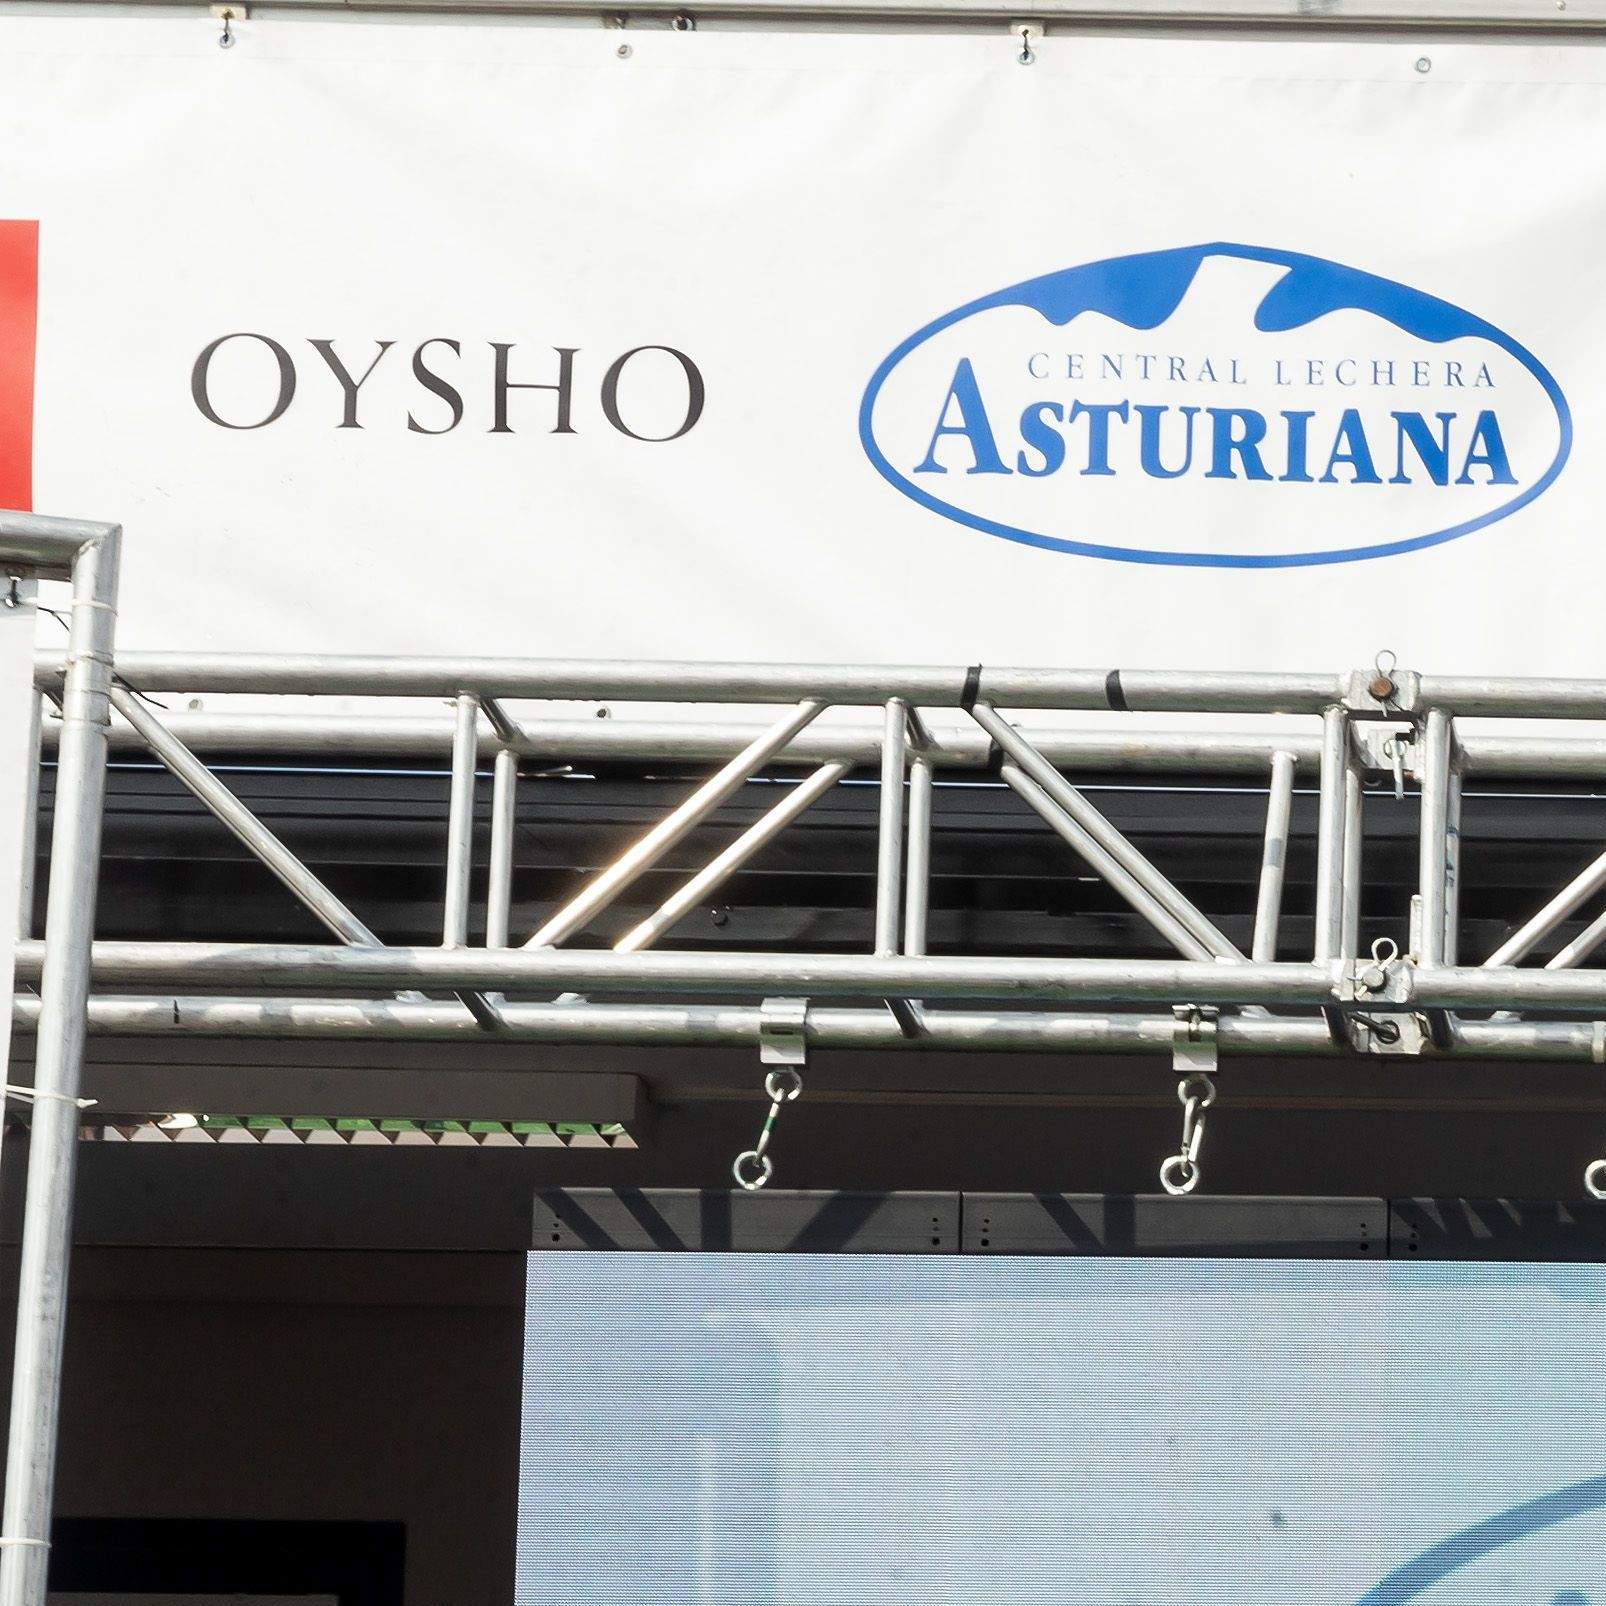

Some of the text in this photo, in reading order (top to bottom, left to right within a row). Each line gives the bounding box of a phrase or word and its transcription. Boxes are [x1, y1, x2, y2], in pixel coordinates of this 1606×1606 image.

[191, 333, 706, 443] OYSHO
[913, 356, 1519, 487] ASTURIANA
[1028, 352, 1496, 390] CENTRAL LECHERA
